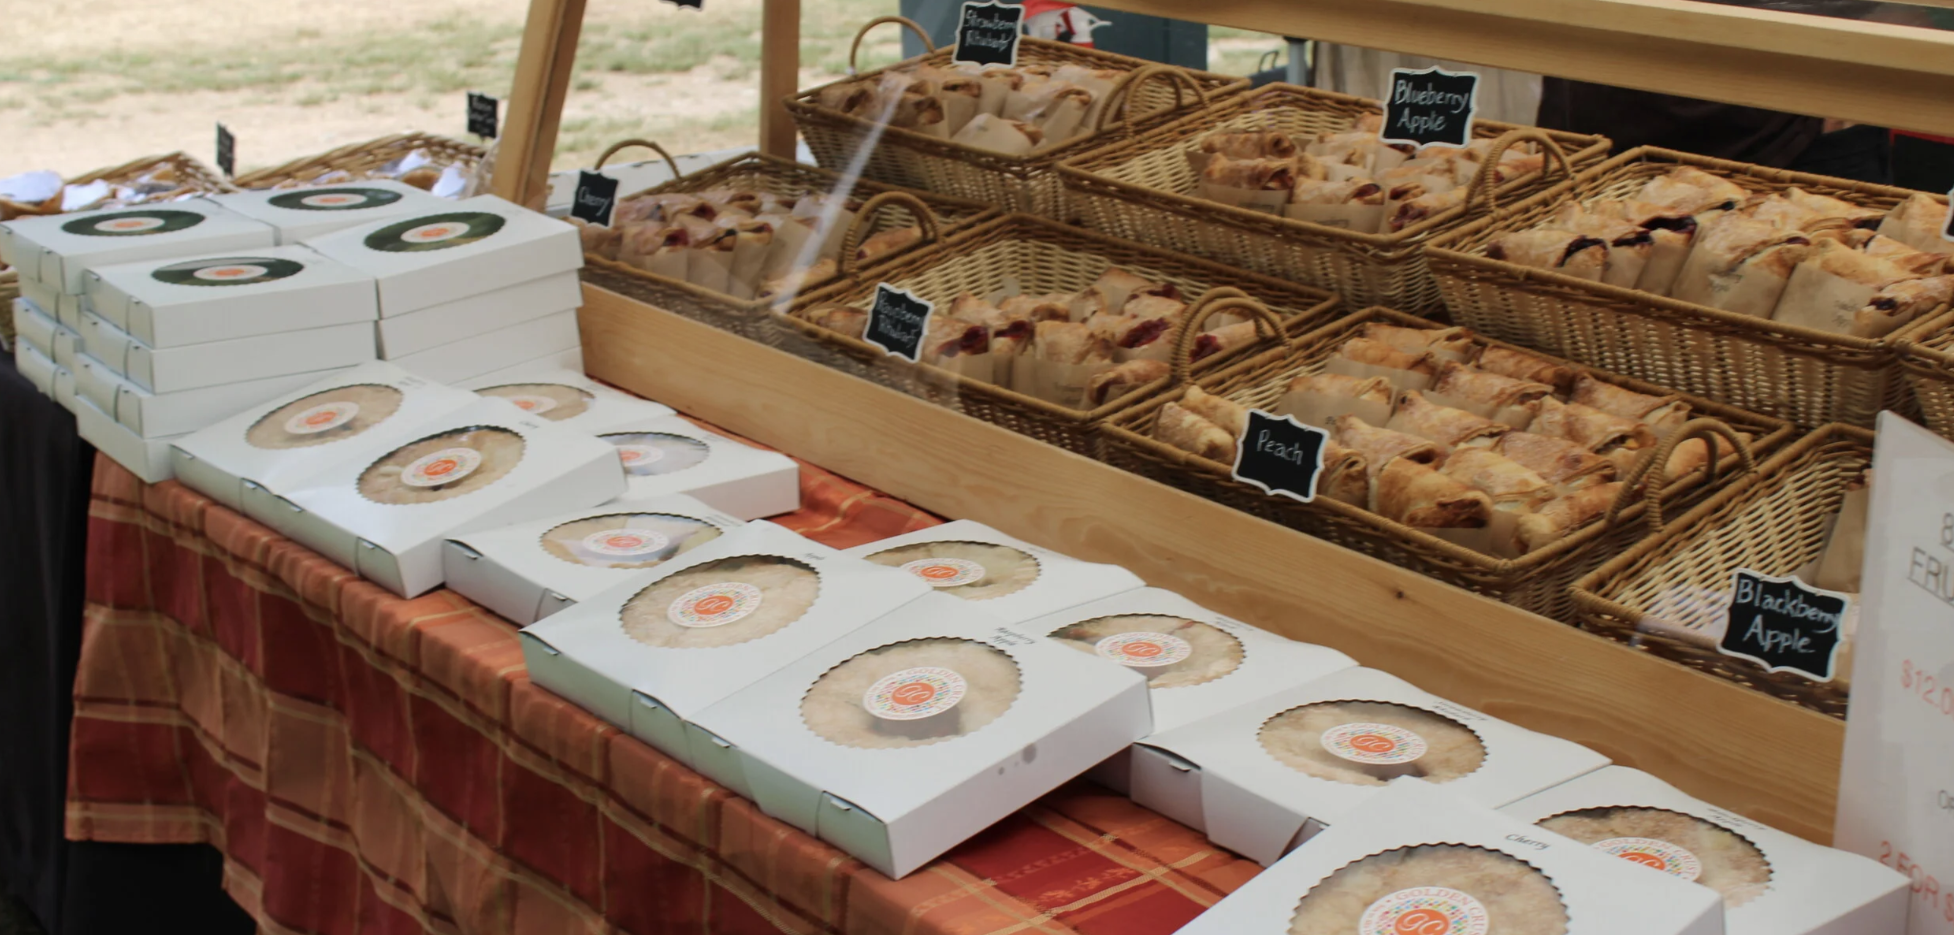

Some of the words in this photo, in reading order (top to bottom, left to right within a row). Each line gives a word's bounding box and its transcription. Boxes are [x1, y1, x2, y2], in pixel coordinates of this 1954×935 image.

[1394, 79, 1470, 114] Blueberry
[1396, 107, 1447, 135] Apple
[577, 185, 611, 218] Cherry
[876, 291, 924, 330] Raspberry
[1256, 428, 1304, 466] Peach
[1735, 578, 1841, 634] Blackberry
[1742, 613, 1816, 654] Apple
[1506, 833, 1551, 851] Cherry
[1395, 888, 1472, 906] GOLDEN
